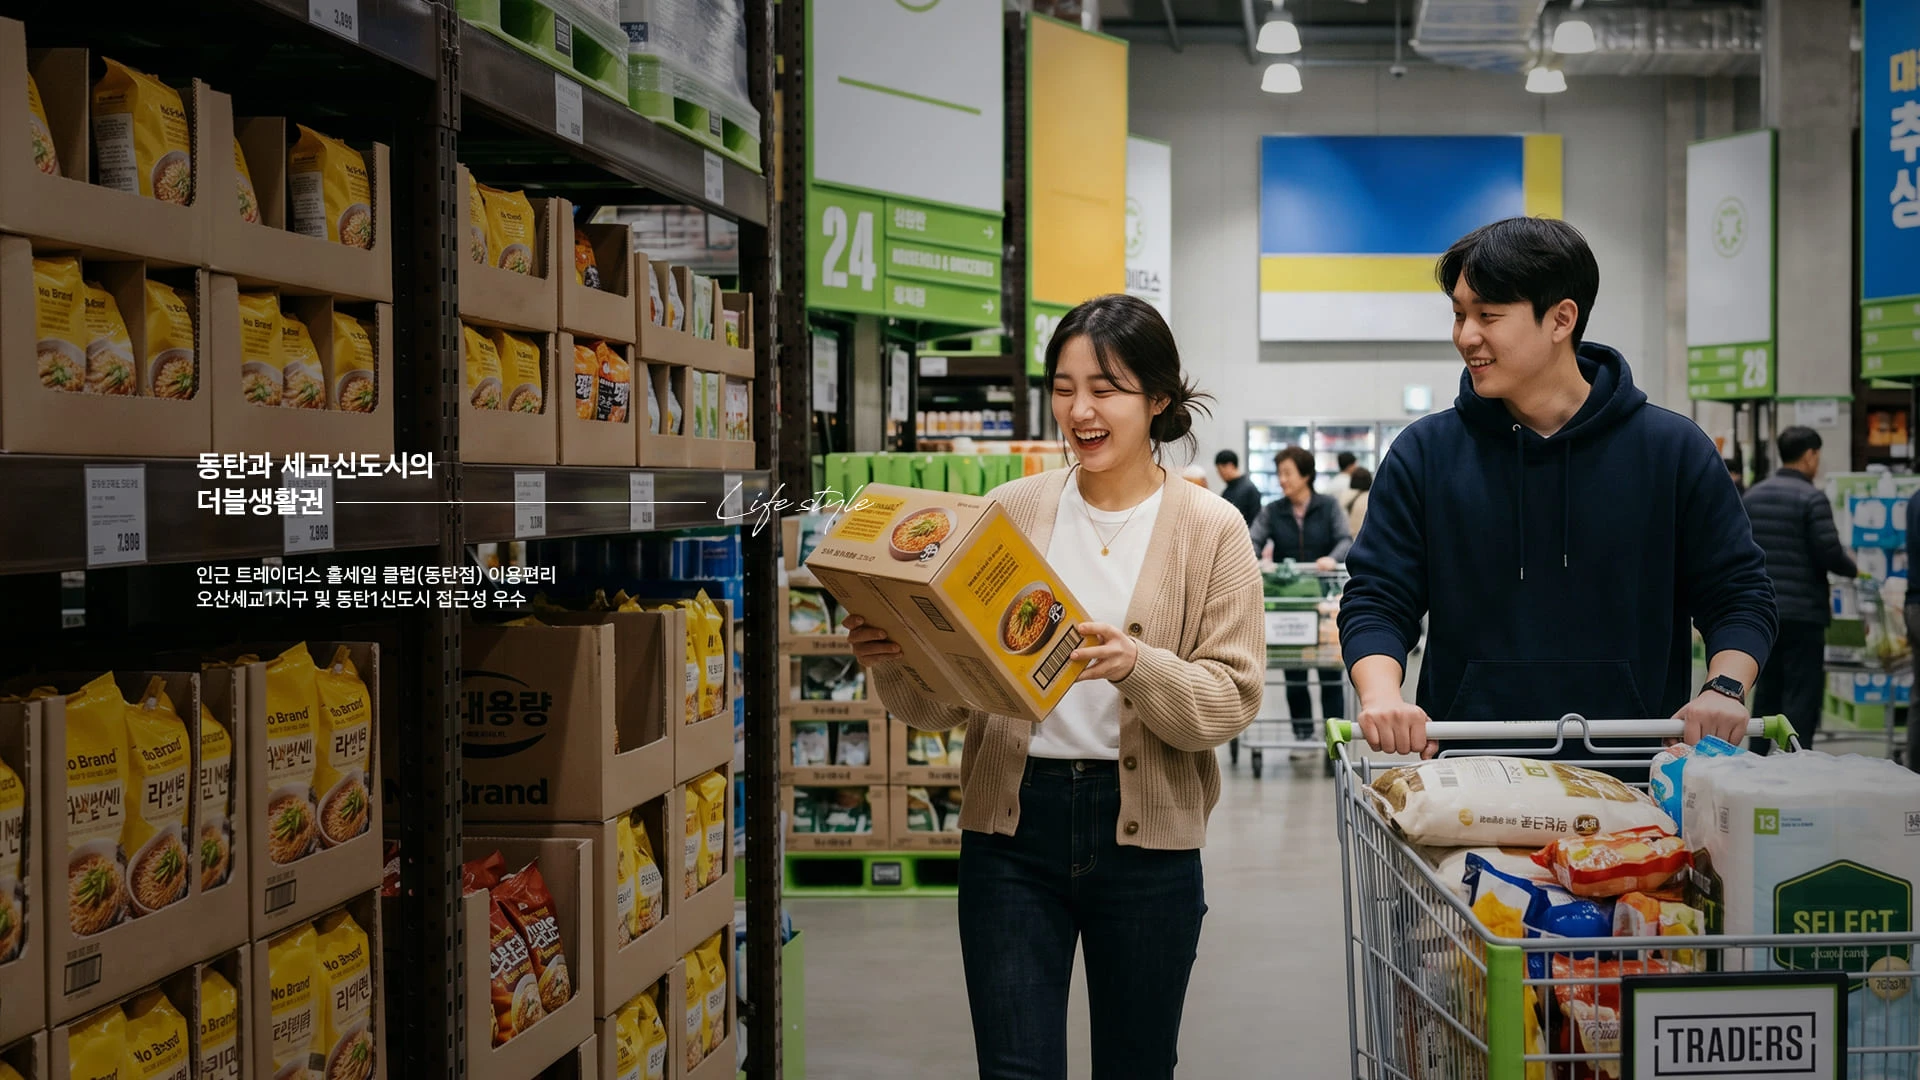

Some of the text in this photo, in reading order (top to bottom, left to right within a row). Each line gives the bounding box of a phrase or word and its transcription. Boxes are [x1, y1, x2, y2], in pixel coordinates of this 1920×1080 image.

[822, 206, 877, 292] 24
[1034, 314, 1061, 363] 3
[275, 704, 309, 724] Brand
[76, 751, 117, 769] Brand
[1757, 815, 1777, 832] 13
[270, 975, 310, 1001] No Brand
[1667, 1025, 1803, 1064] TRADERS
